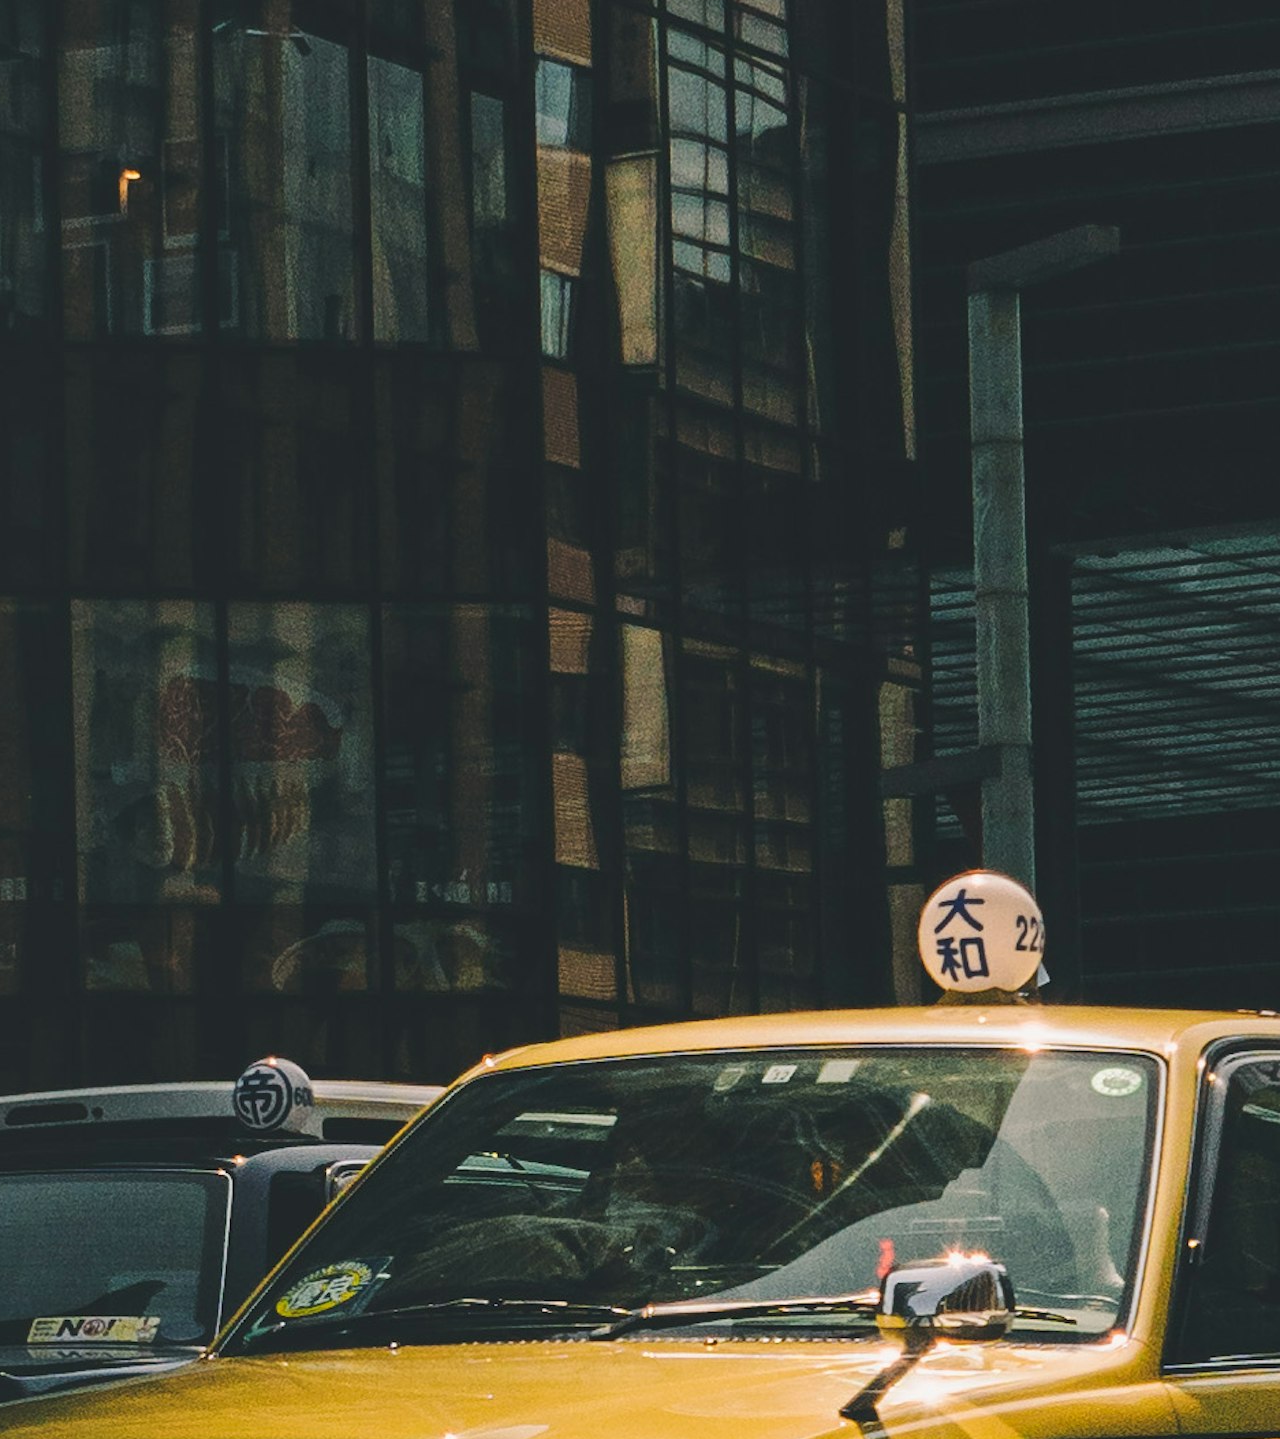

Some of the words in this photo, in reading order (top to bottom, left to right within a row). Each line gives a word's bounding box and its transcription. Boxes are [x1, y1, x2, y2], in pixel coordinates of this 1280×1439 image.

[934, 888, 989, 982] 大和
[1015, 915, 1045, 953] 22
[236, 1067, 285, 1126] 帝
